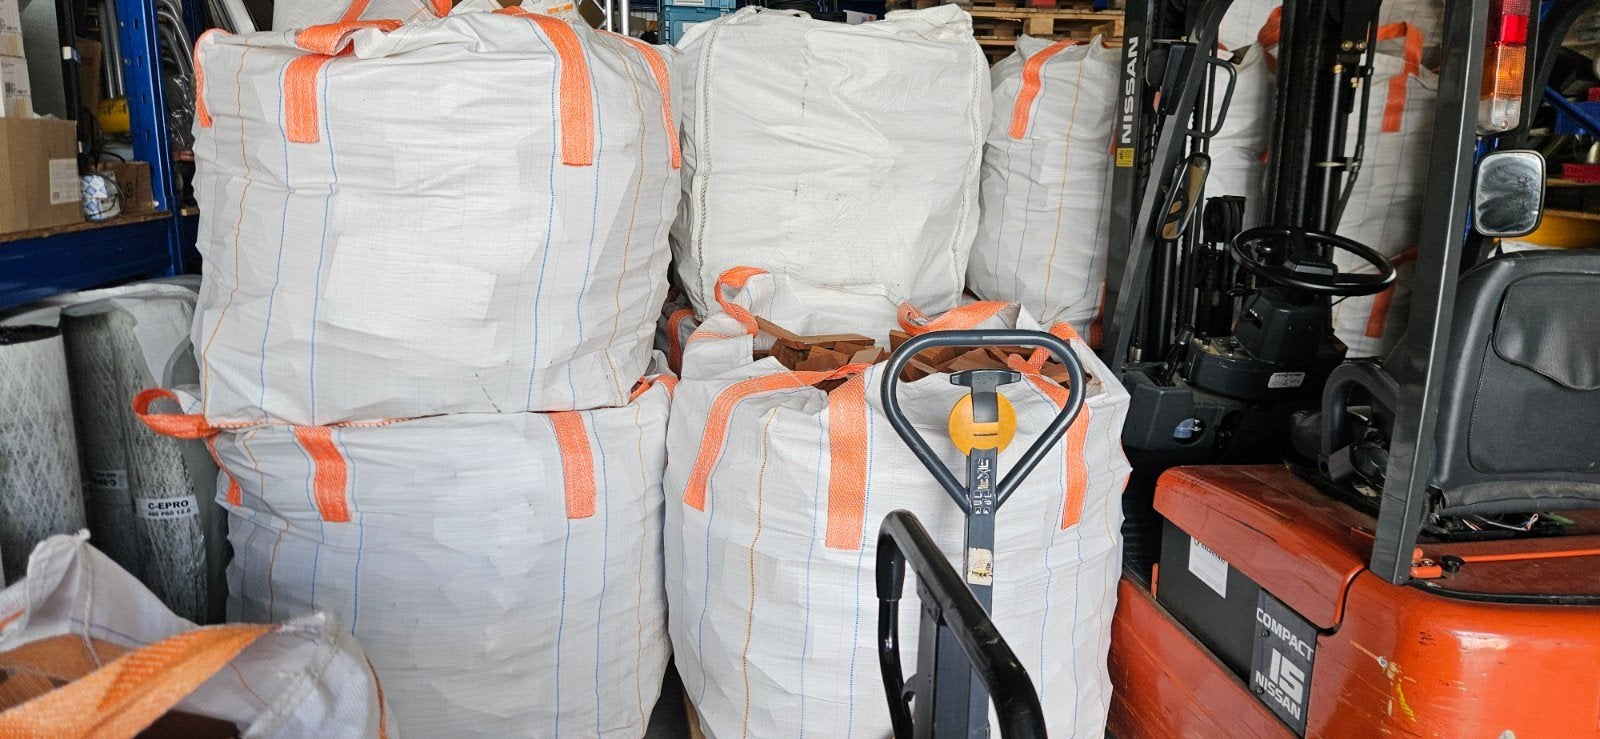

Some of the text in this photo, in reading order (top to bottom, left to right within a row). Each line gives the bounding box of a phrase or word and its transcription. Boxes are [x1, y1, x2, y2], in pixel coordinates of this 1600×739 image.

[1121, 36, 1139, 144] NISSAN
[148, 500, 189, 510] C-EPRO
[1256, 607, 1314, 660] COMPACT
[1255, 670, 1301, 720] NISSAN
[1270, 648, 1305, 704] 15
